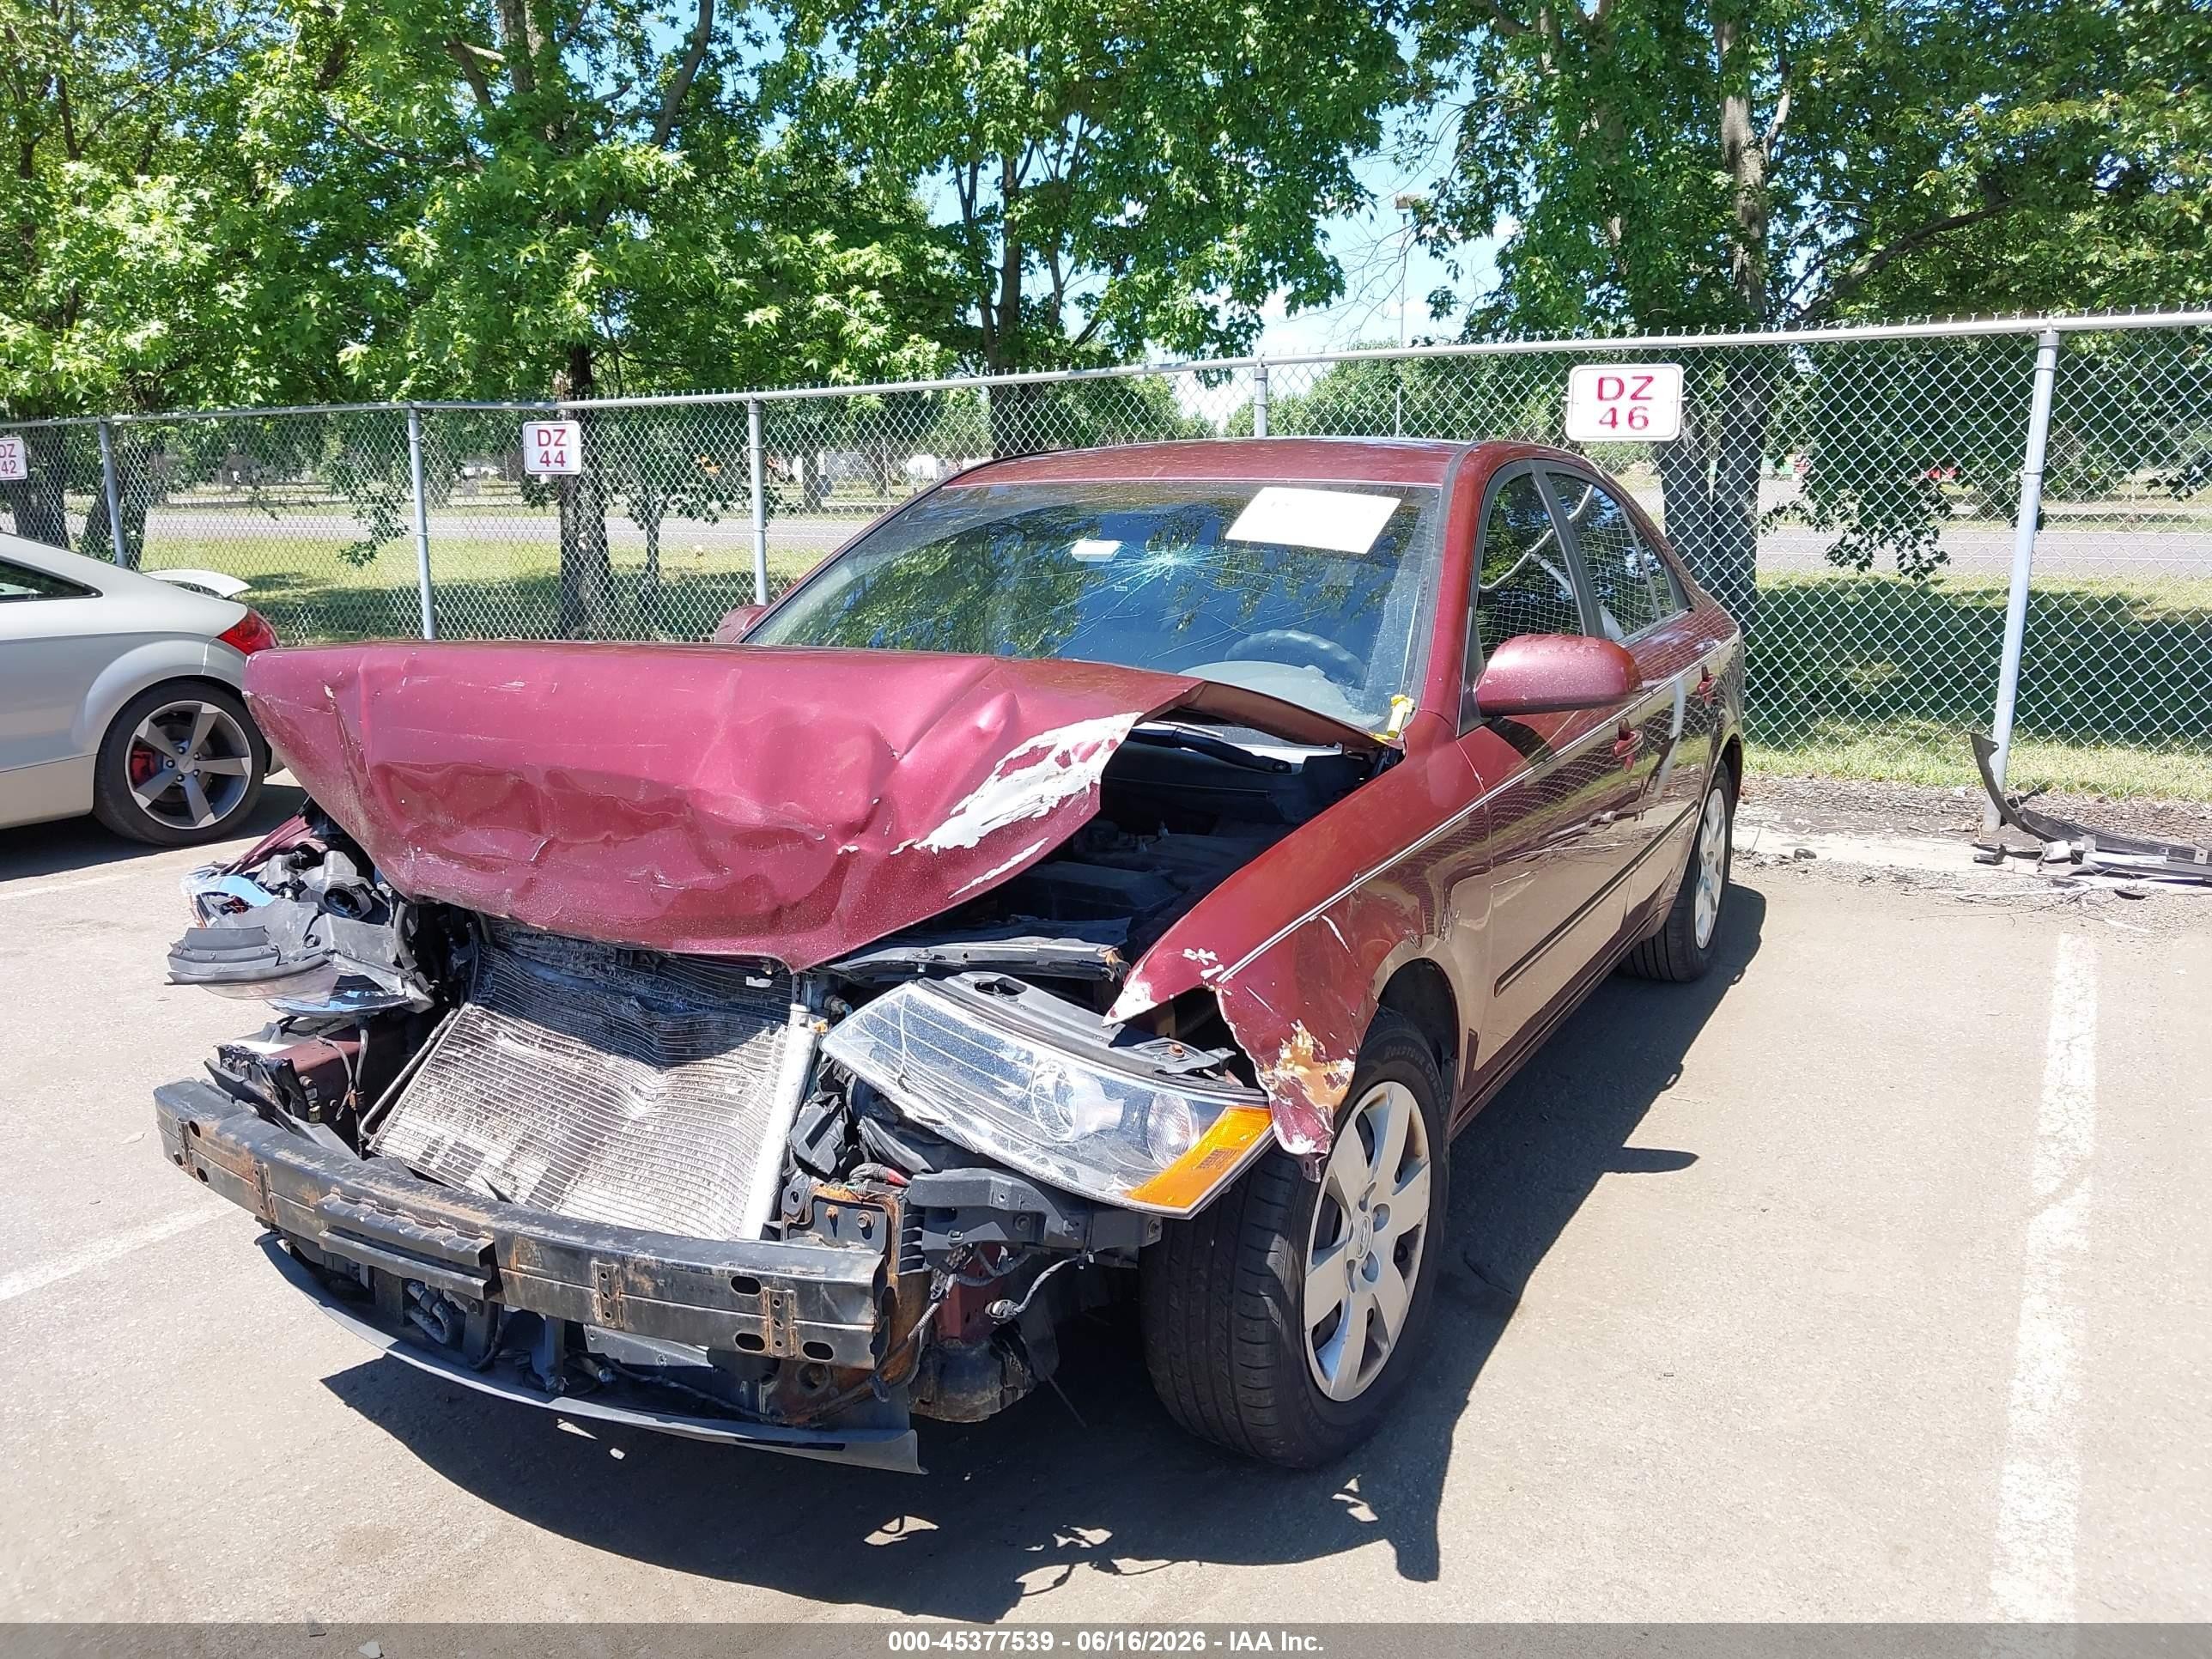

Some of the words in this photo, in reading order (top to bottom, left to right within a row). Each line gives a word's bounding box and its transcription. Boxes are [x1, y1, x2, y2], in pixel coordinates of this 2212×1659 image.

[1598, 376, 1654, 401] DZ
[1599, 406, 1649, 430] 46
[538, 428, 567, 447] DZ
[2, 459, 17, 474] 42
[539, 450, 566, 467] 44
